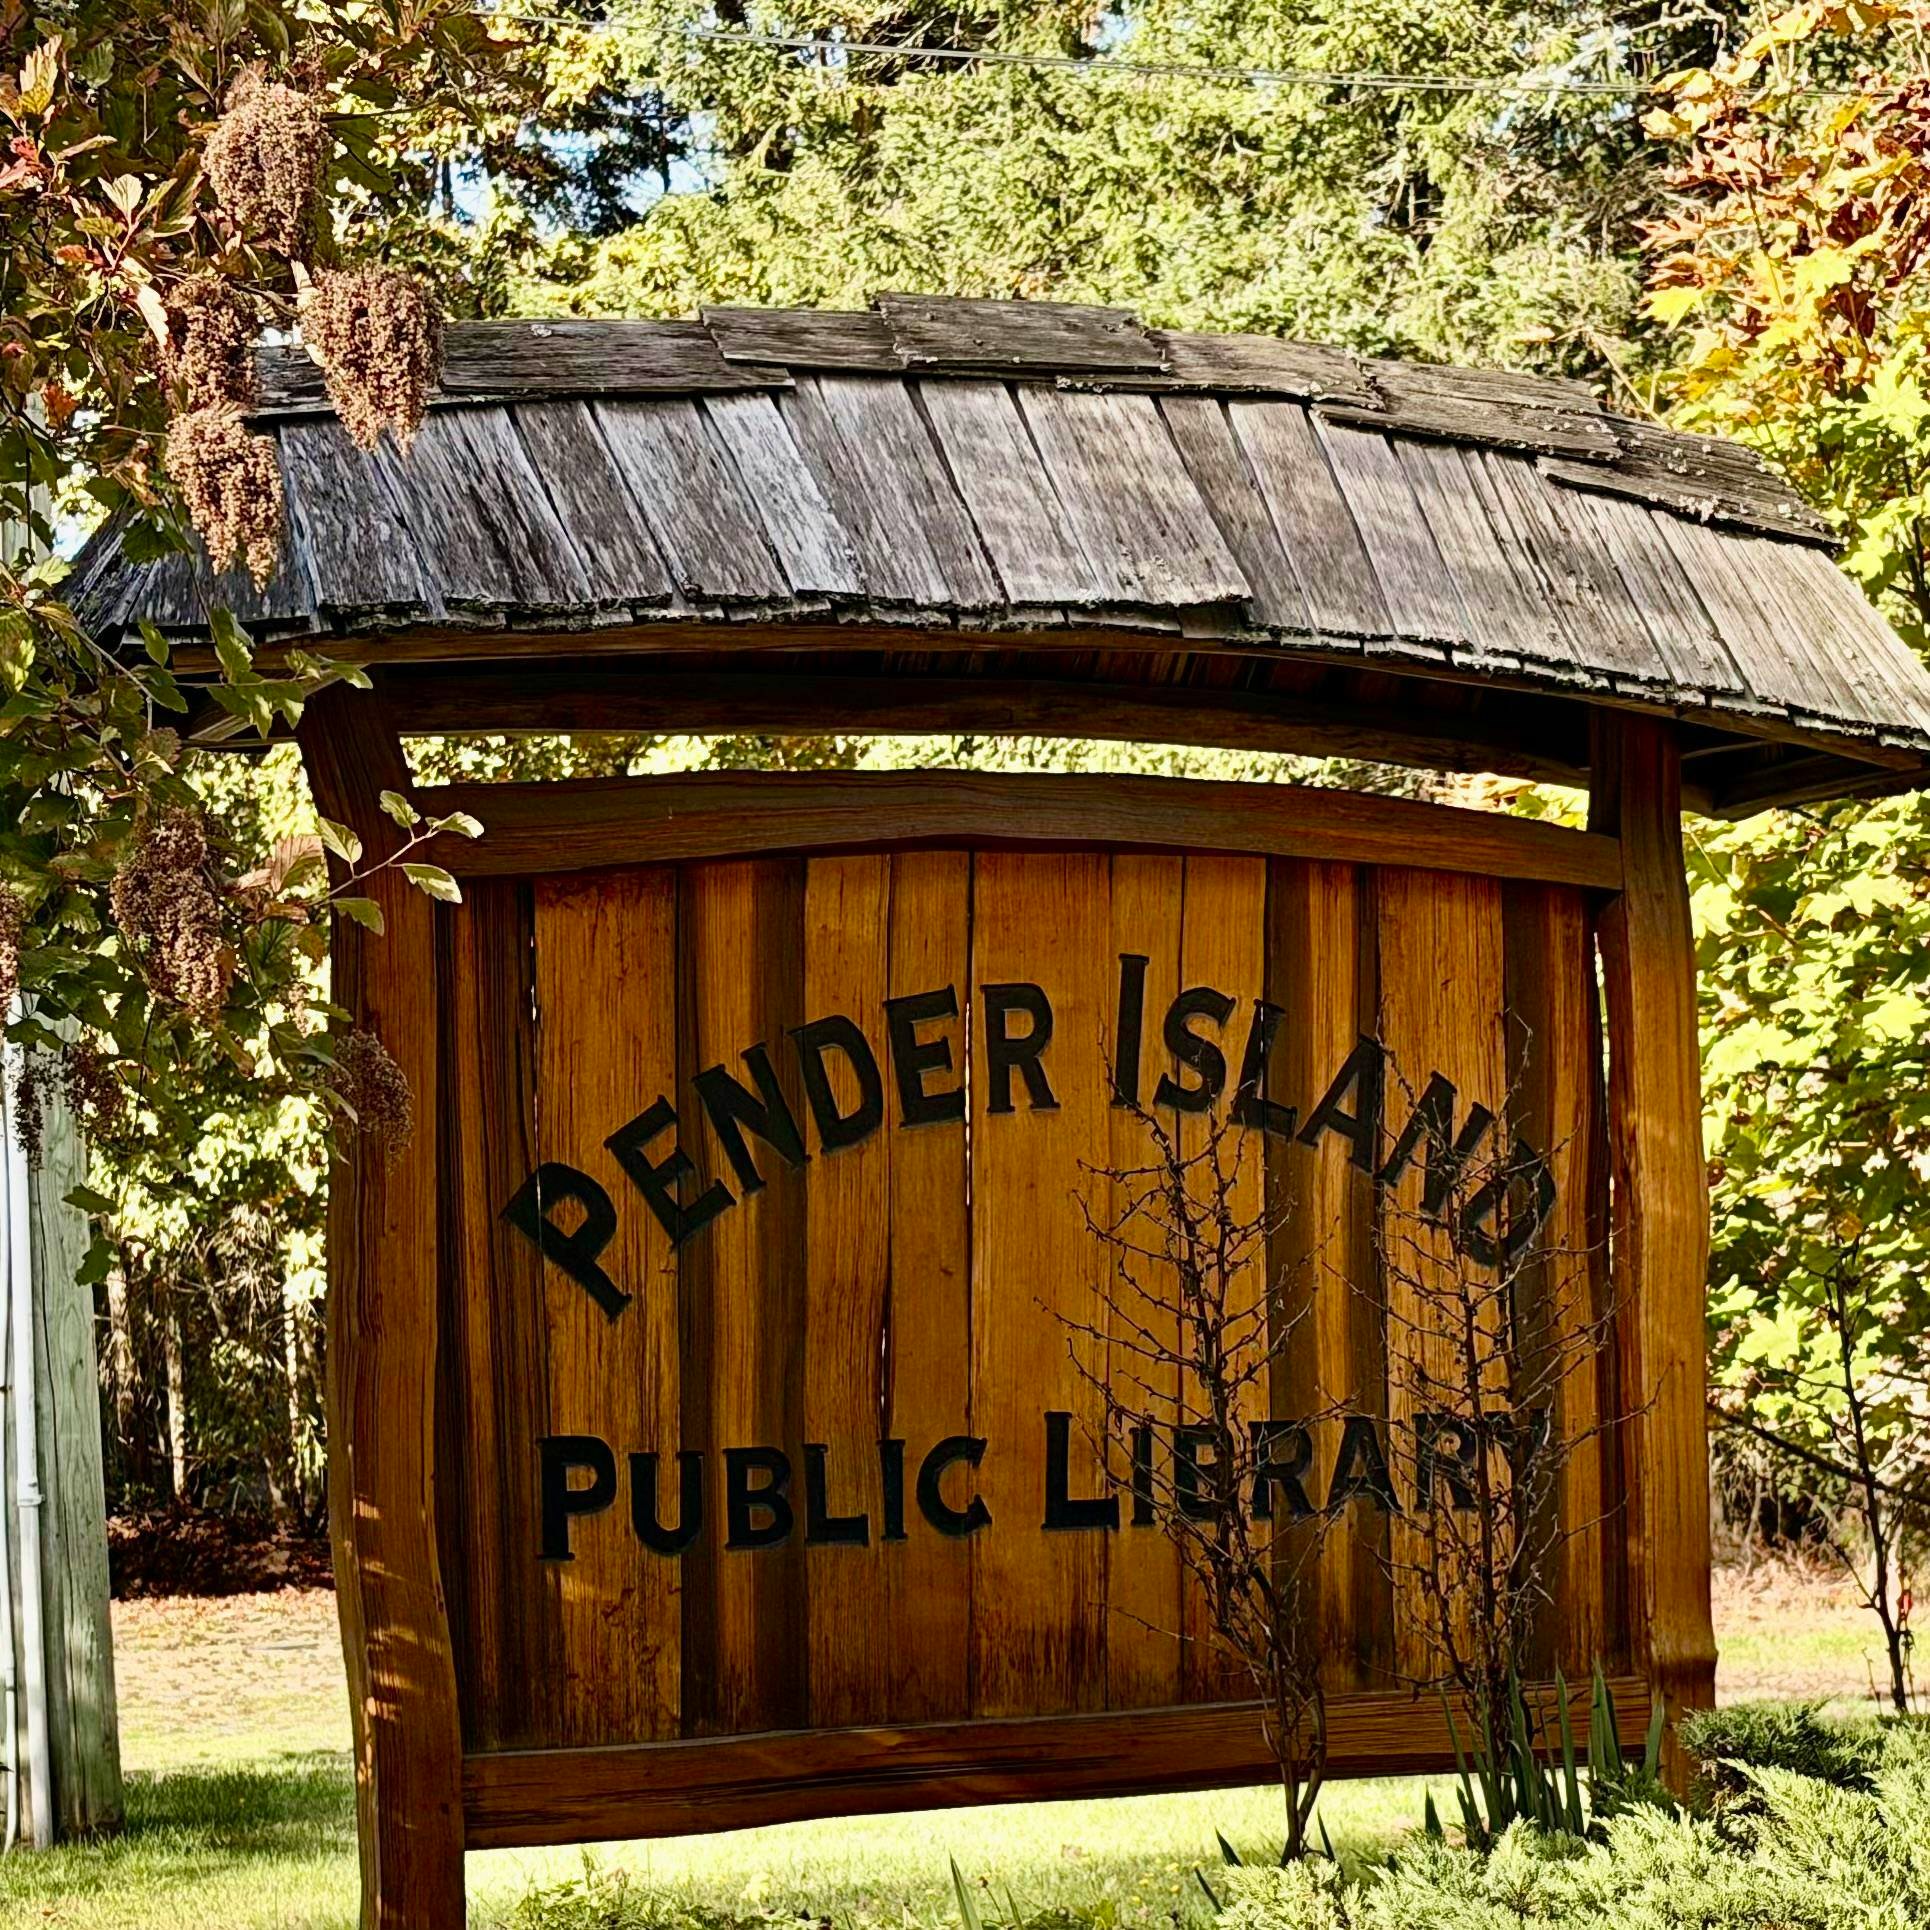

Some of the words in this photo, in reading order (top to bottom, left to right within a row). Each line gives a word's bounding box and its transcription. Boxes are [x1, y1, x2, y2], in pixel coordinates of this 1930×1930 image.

[500, 983, 1060, 1324] PENDER
[1111, 953, 1557, 1266] ISLAND
[536, 1435, 993, 1560] PUBLIC
